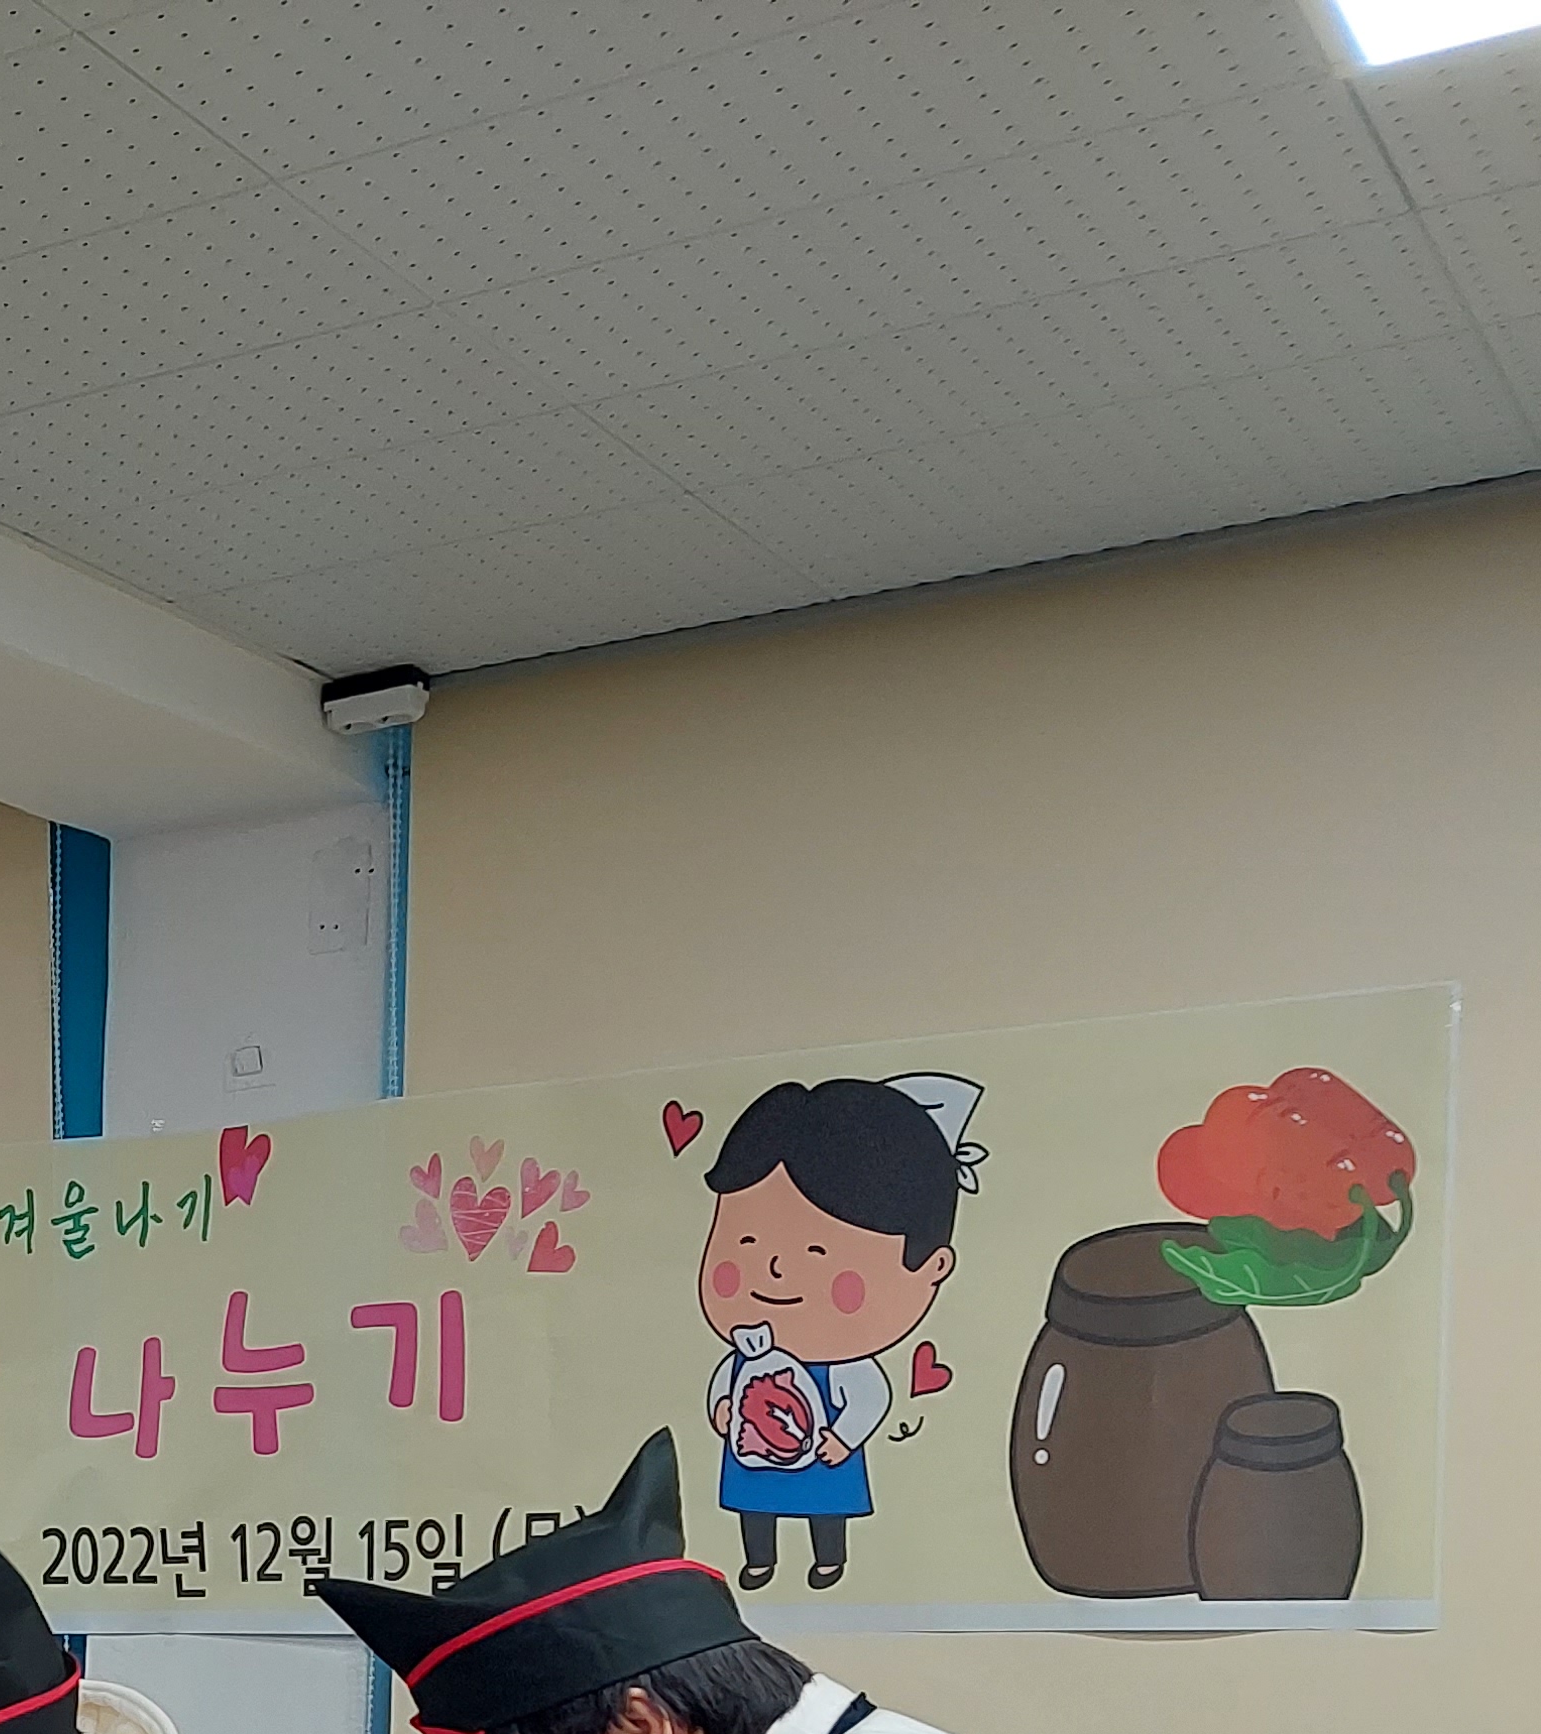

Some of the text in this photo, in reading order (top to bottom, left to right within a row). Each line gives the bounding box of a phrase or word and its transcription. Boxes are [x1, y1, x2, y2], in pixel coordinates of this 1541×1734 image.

[69, 1289, 466, 1460] 나누기
[42, 1521, 206, 1598] 2022년
[230, 1515, 332, 1597] 12월
[359, 1513, 463, 1595] 15일
